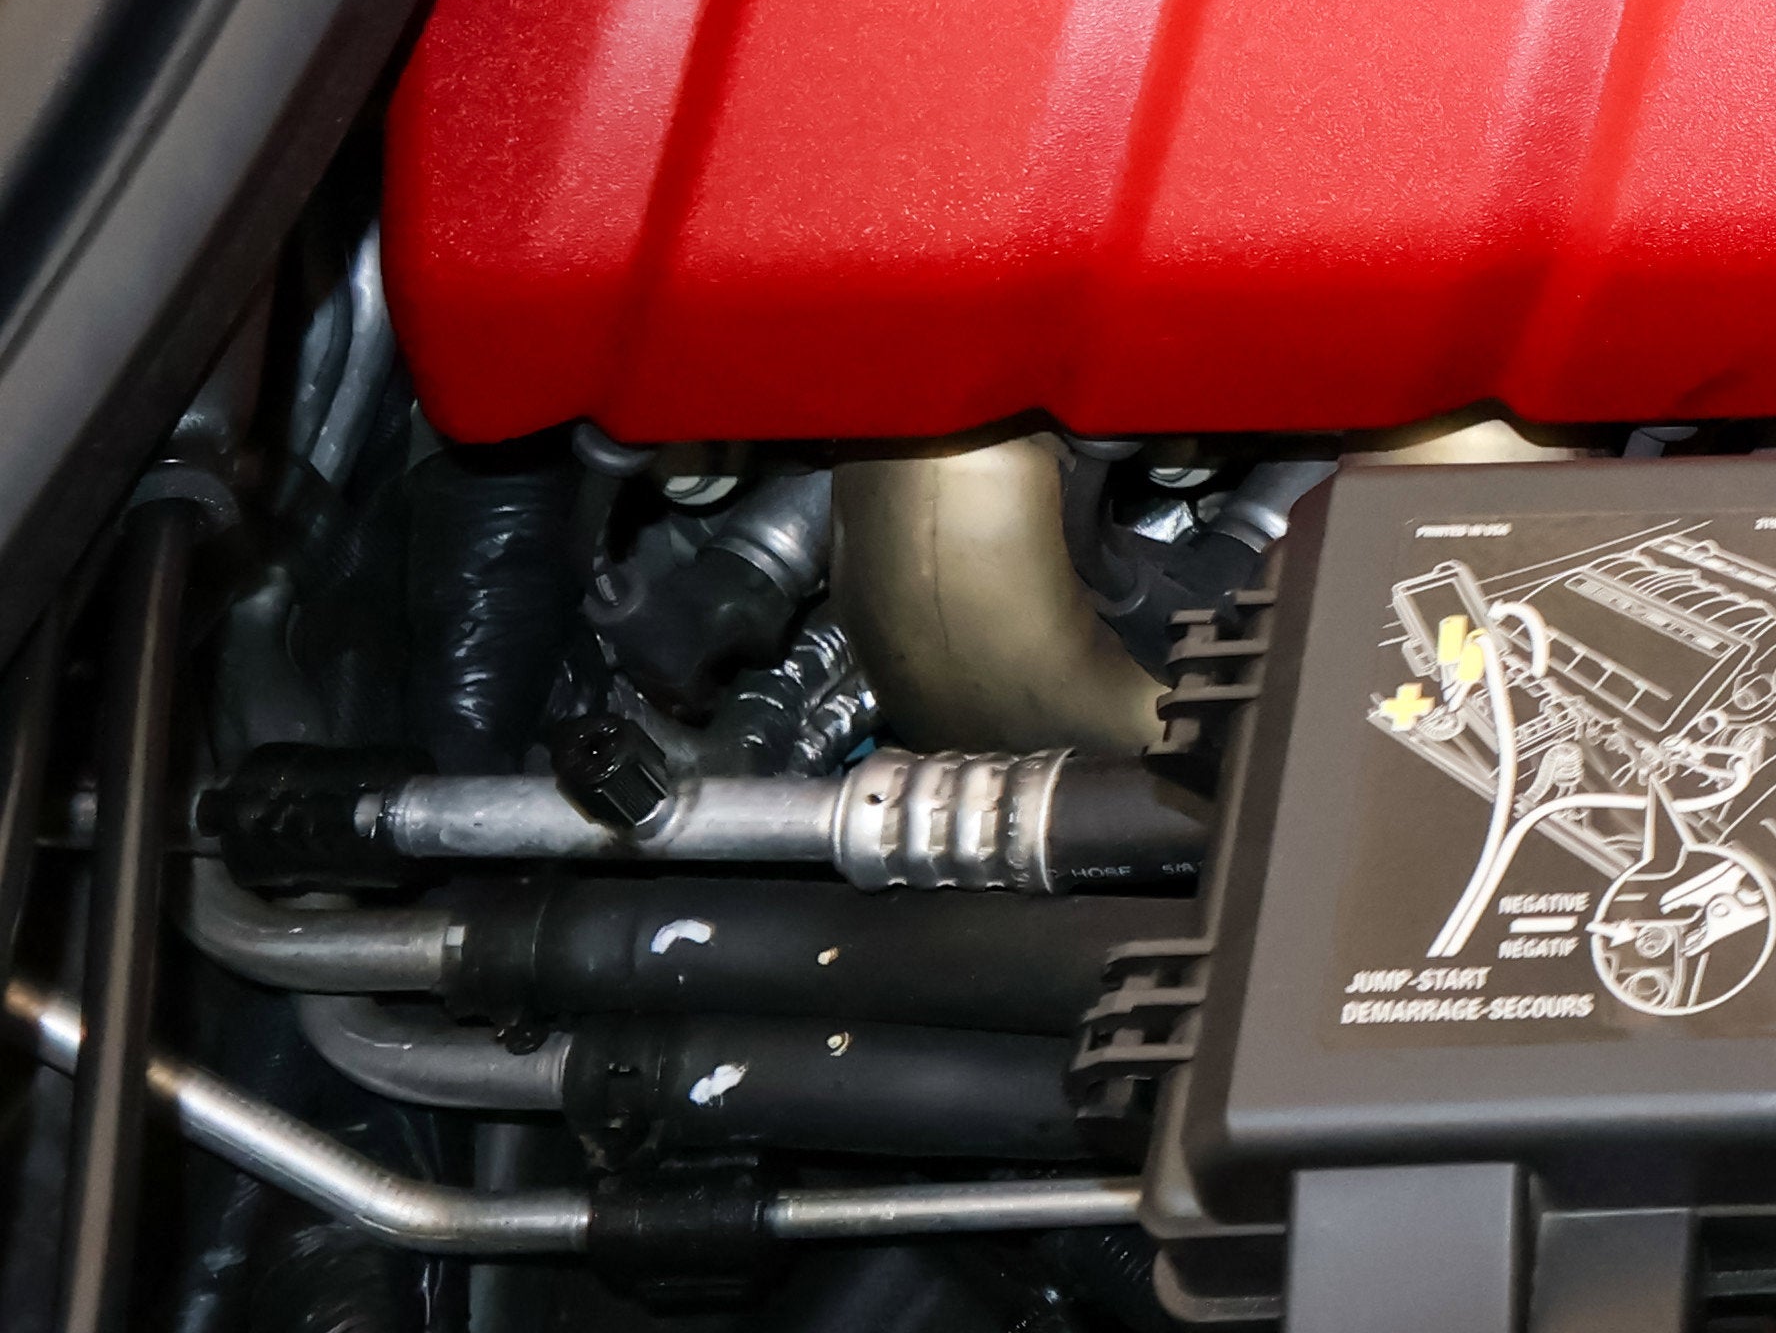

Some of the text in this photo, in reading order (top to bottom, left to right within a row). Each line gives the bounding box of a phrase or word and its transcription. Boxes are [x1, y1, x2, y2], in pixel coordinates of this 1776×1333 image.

[1497, 891, 1591, 916] NEGATIVE
[1497, 935, 1580, 960] NÉGATIF
[1344, 965, 1493, 995] JUMP-START
